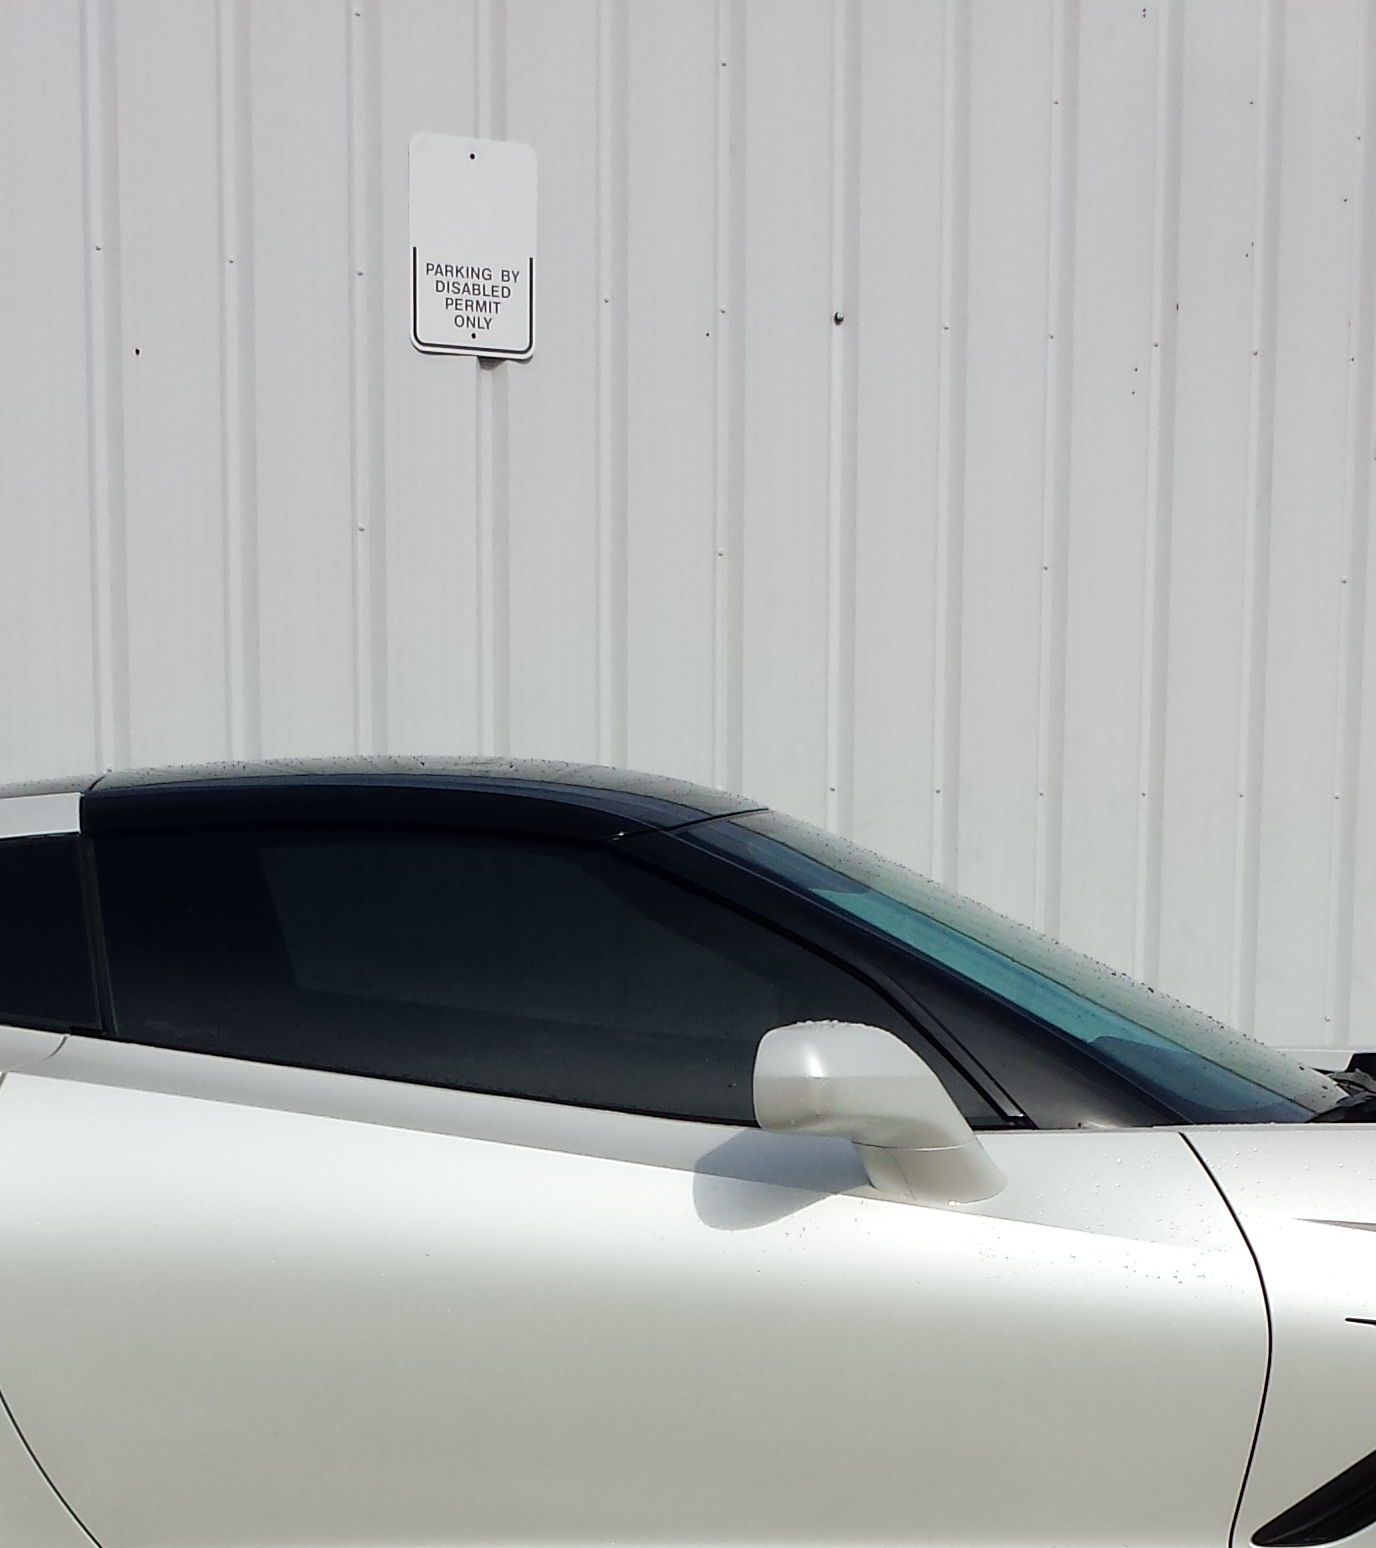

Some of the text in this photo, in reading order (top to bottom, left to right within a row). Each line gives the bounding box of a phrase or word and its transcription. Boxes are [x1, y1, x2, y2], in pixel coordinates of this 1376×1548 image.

[426, 262, 520, 283] PARKING BY
[435, 280, 511, 299] DISABLED
[445, 298, 501, 314] PERMIT
[454, 315, 492, 330] ONLY
